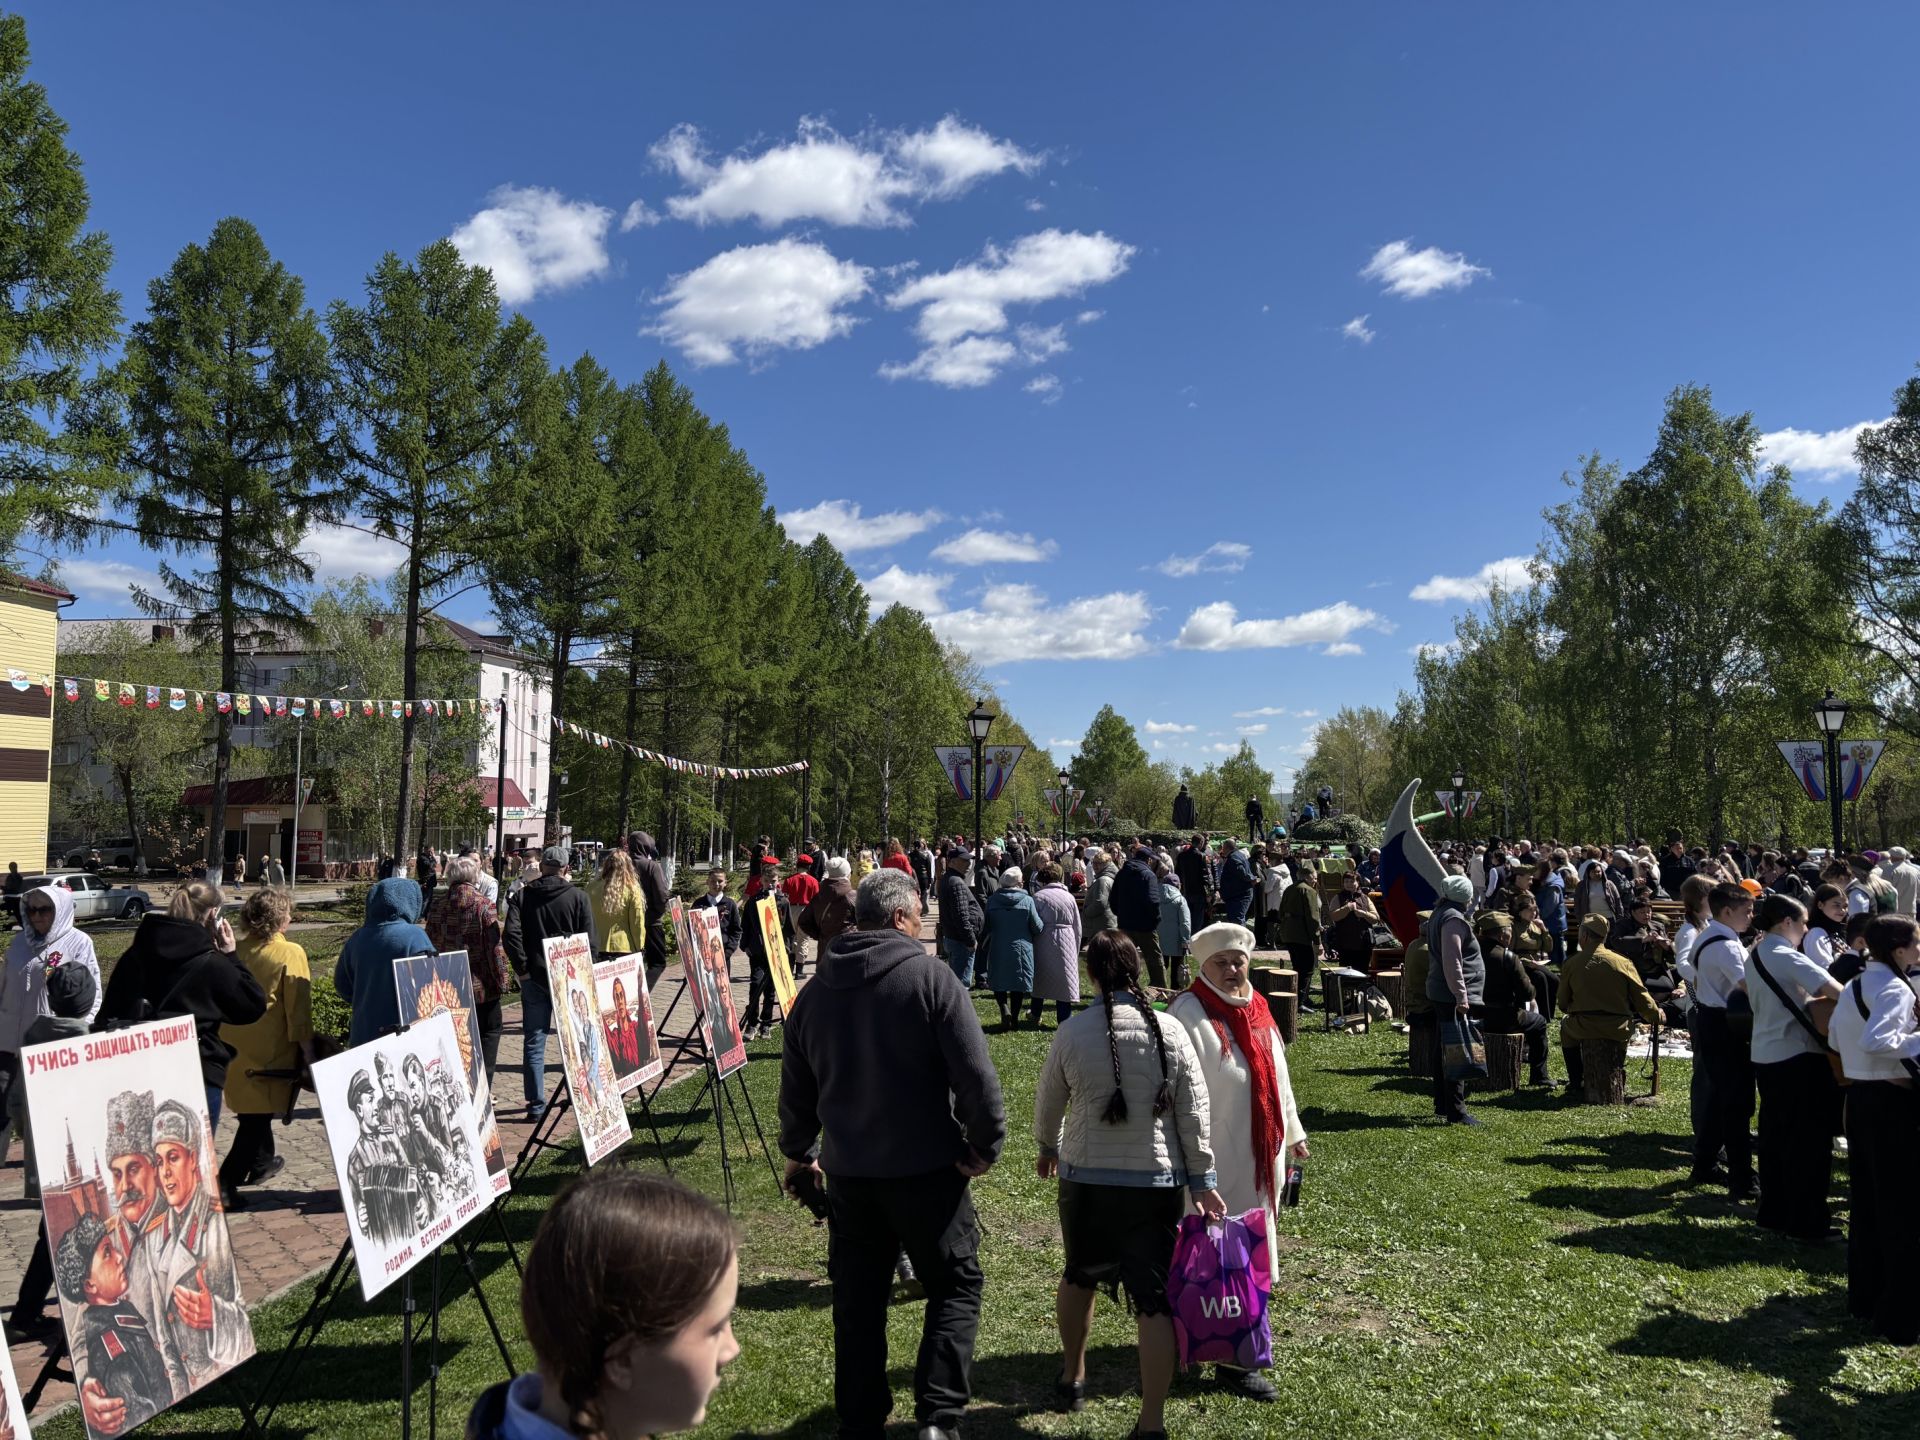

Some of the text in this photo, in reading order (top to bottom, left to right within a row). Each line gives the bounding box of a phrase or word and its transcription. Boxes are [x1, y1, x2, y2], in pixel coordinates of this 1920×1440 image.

[27, 1020, 195, 1075] УЧИСЬ ЗАЩИЩАТЬ РОДИНУ!
[420, 1214, 452, 1248] ВСТРЕЧАЙ
[456, 1193, 480, 1220] ГЕРОЕВ!
[1200, 1295, 1242, 1319] WB
